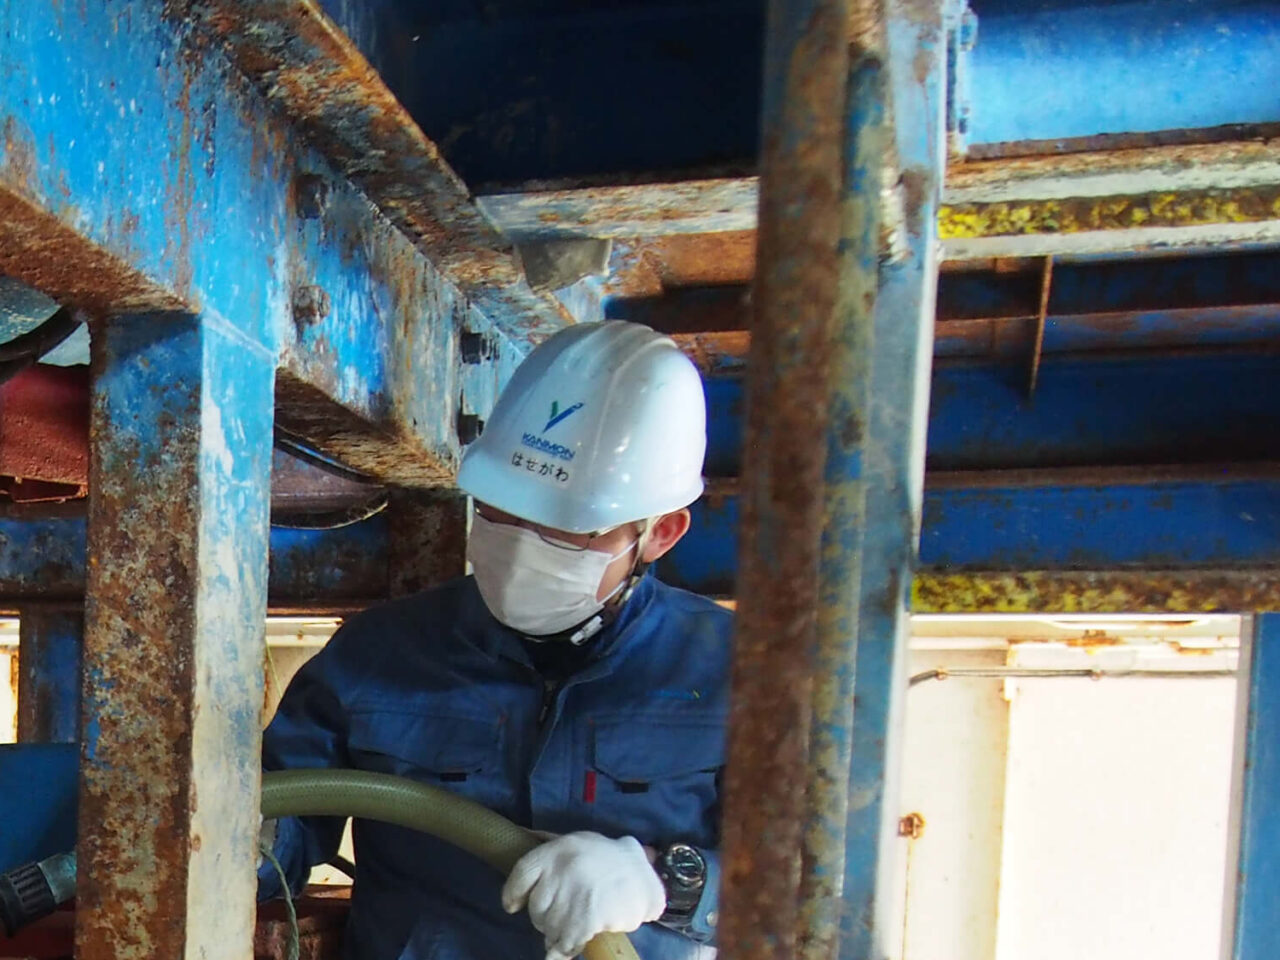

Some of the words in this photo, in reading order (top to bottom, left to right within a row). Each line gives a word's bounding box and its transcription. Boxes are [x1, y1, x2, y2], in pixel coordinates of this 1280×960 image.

[522, 432, 576, 459] KANMON
[511, 451, 569, 482] はせがわ
